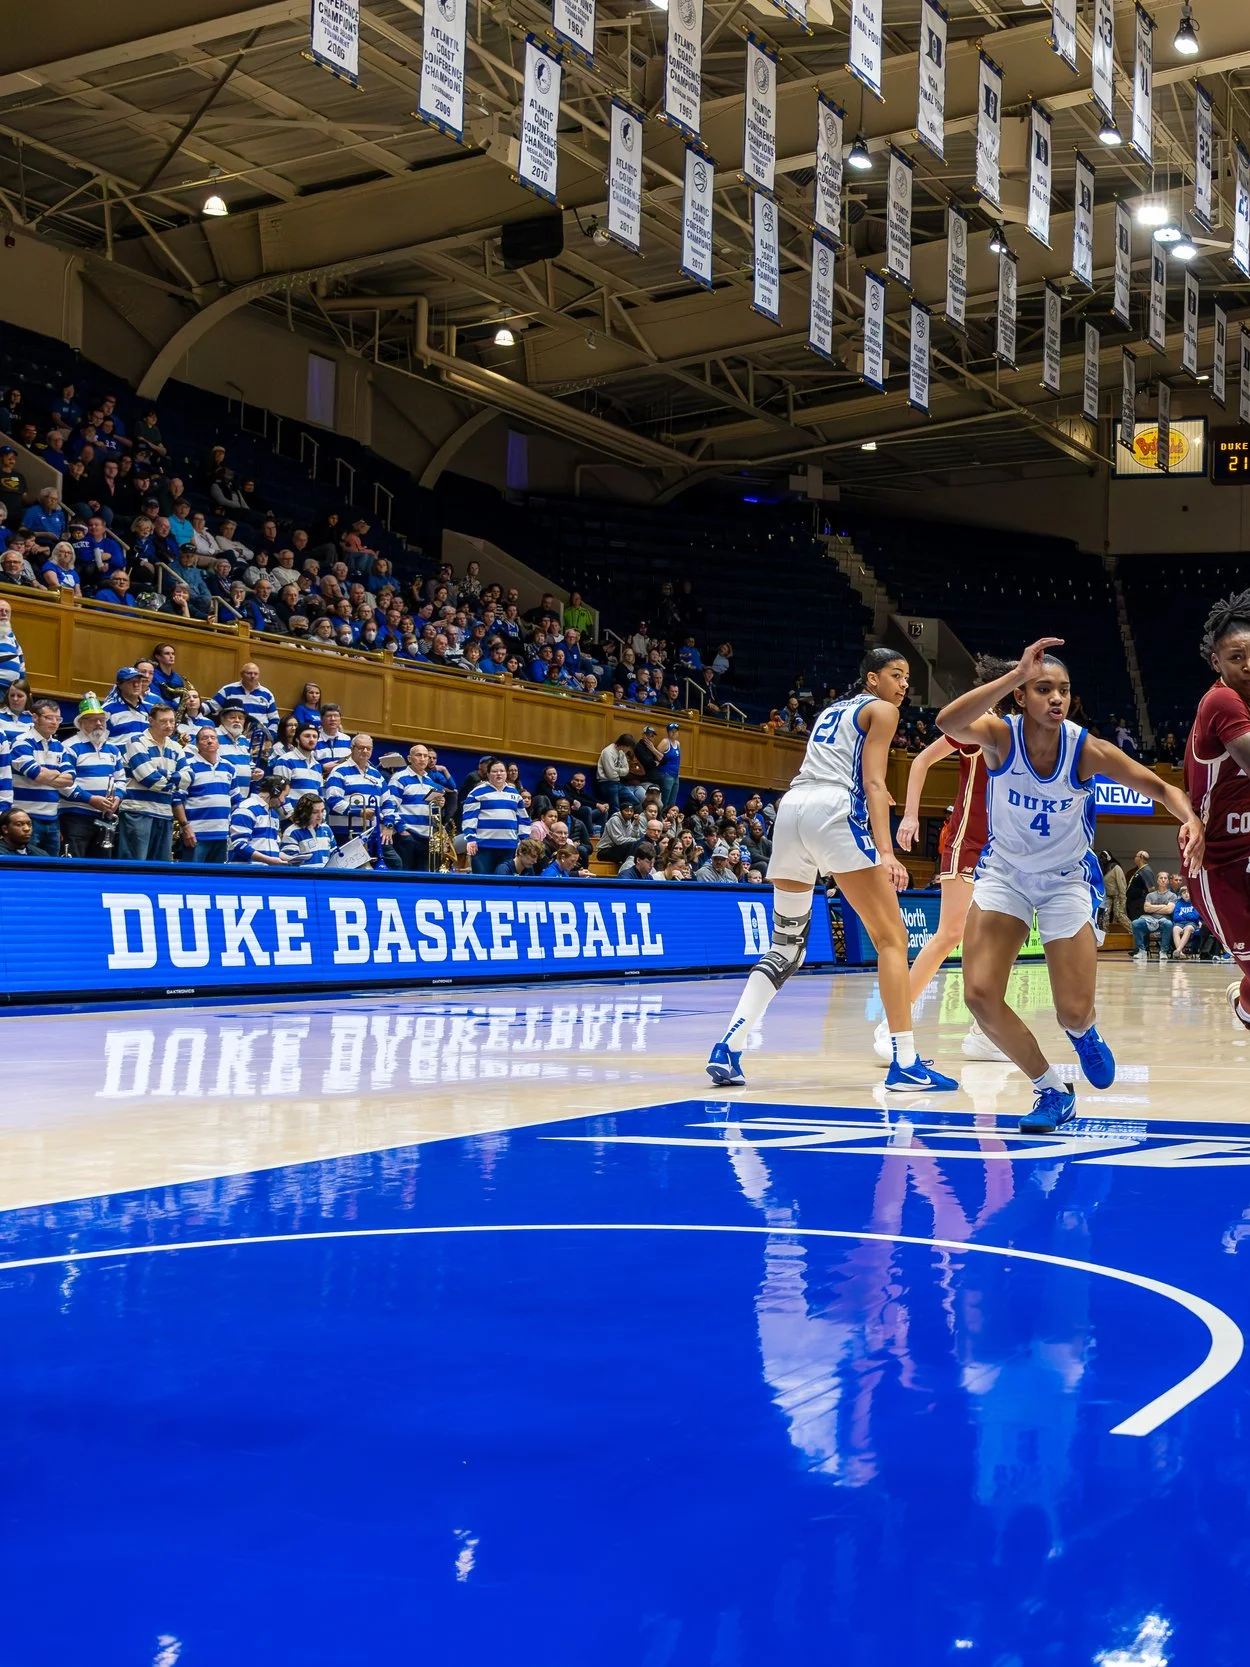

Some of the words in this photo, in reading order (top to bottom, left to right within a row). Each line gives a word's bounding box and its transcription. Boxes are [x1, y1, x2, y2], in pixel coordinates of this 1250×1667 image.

[319, 2, 357, 35] CHAMPIONS
[431, 27, 459, 52] ATLANTIC
[674, 32, 697, 57] ATLANTIC
[437, 43, 455, 62] COAST
[678, 48, 693, 66] COAST
[861, 53, 874, 71] 1990
[424, 50, 463, 82] CONFERENCE
[425, 65, 461, 94] CHAMPIONS
[435, 99, 451, 117] 2009
[530, 99, 553, 122] ATLANTIC
[524, 120, 557, 150] CONFERENCE
[524, 134, 555, 160] CHAMPIONS
[531, 165, 548, 182] 2010
[1220, 442, 1249, 451] DUKE
[1229, 456, 1248, 471] 21
[912, 625, 921, 636] 12
[813, 710, 847, 744] 21
[1007, 788, 1074, 813] DUKE
[1029, 813, 1051, 837] 4
[900, 907, 927, 928] North
[101, 893, 312, 970] DUKE
[330, 897, 664, 966] BASKETBALL
